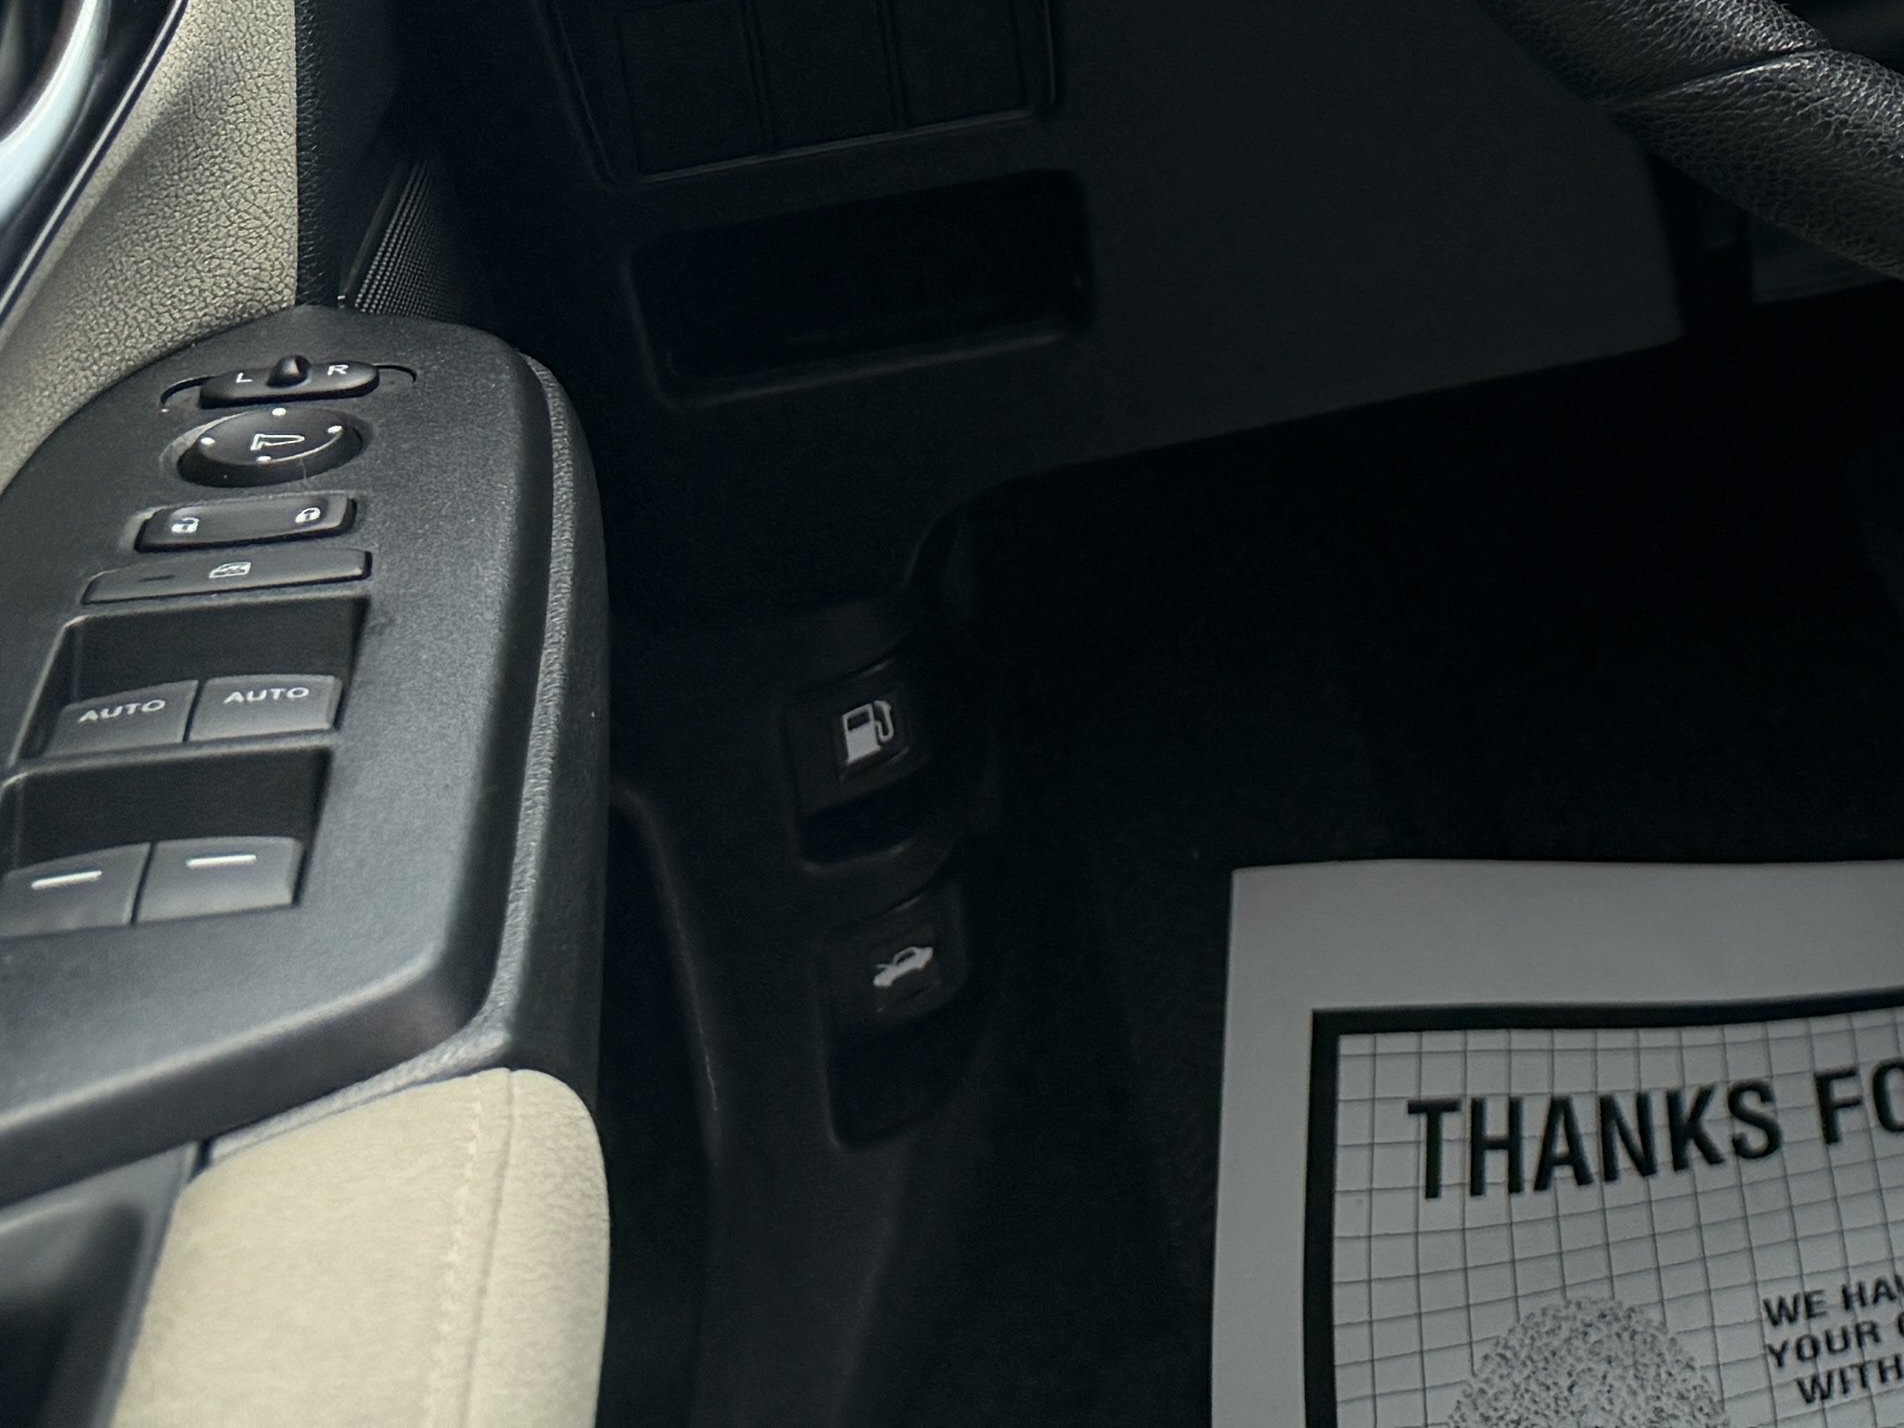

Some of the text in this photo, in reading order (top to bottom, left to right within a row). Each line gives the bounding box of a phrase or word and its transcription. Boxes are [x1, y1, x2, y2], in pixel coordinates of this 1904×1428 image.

[235, 371, 253, 384] L
[326, 363, 349, 376] R
[77, 699, 167, 724] AUTO
[223, 686, 310, 705] AUTO
[1406, 1077, 1783, 1201] THANKS
[1762, 1288, 1829, 1328] WE
[1764, 1318, 1883, 1371] YOUR
[1796, 1352, 1904, 1406] WITH
